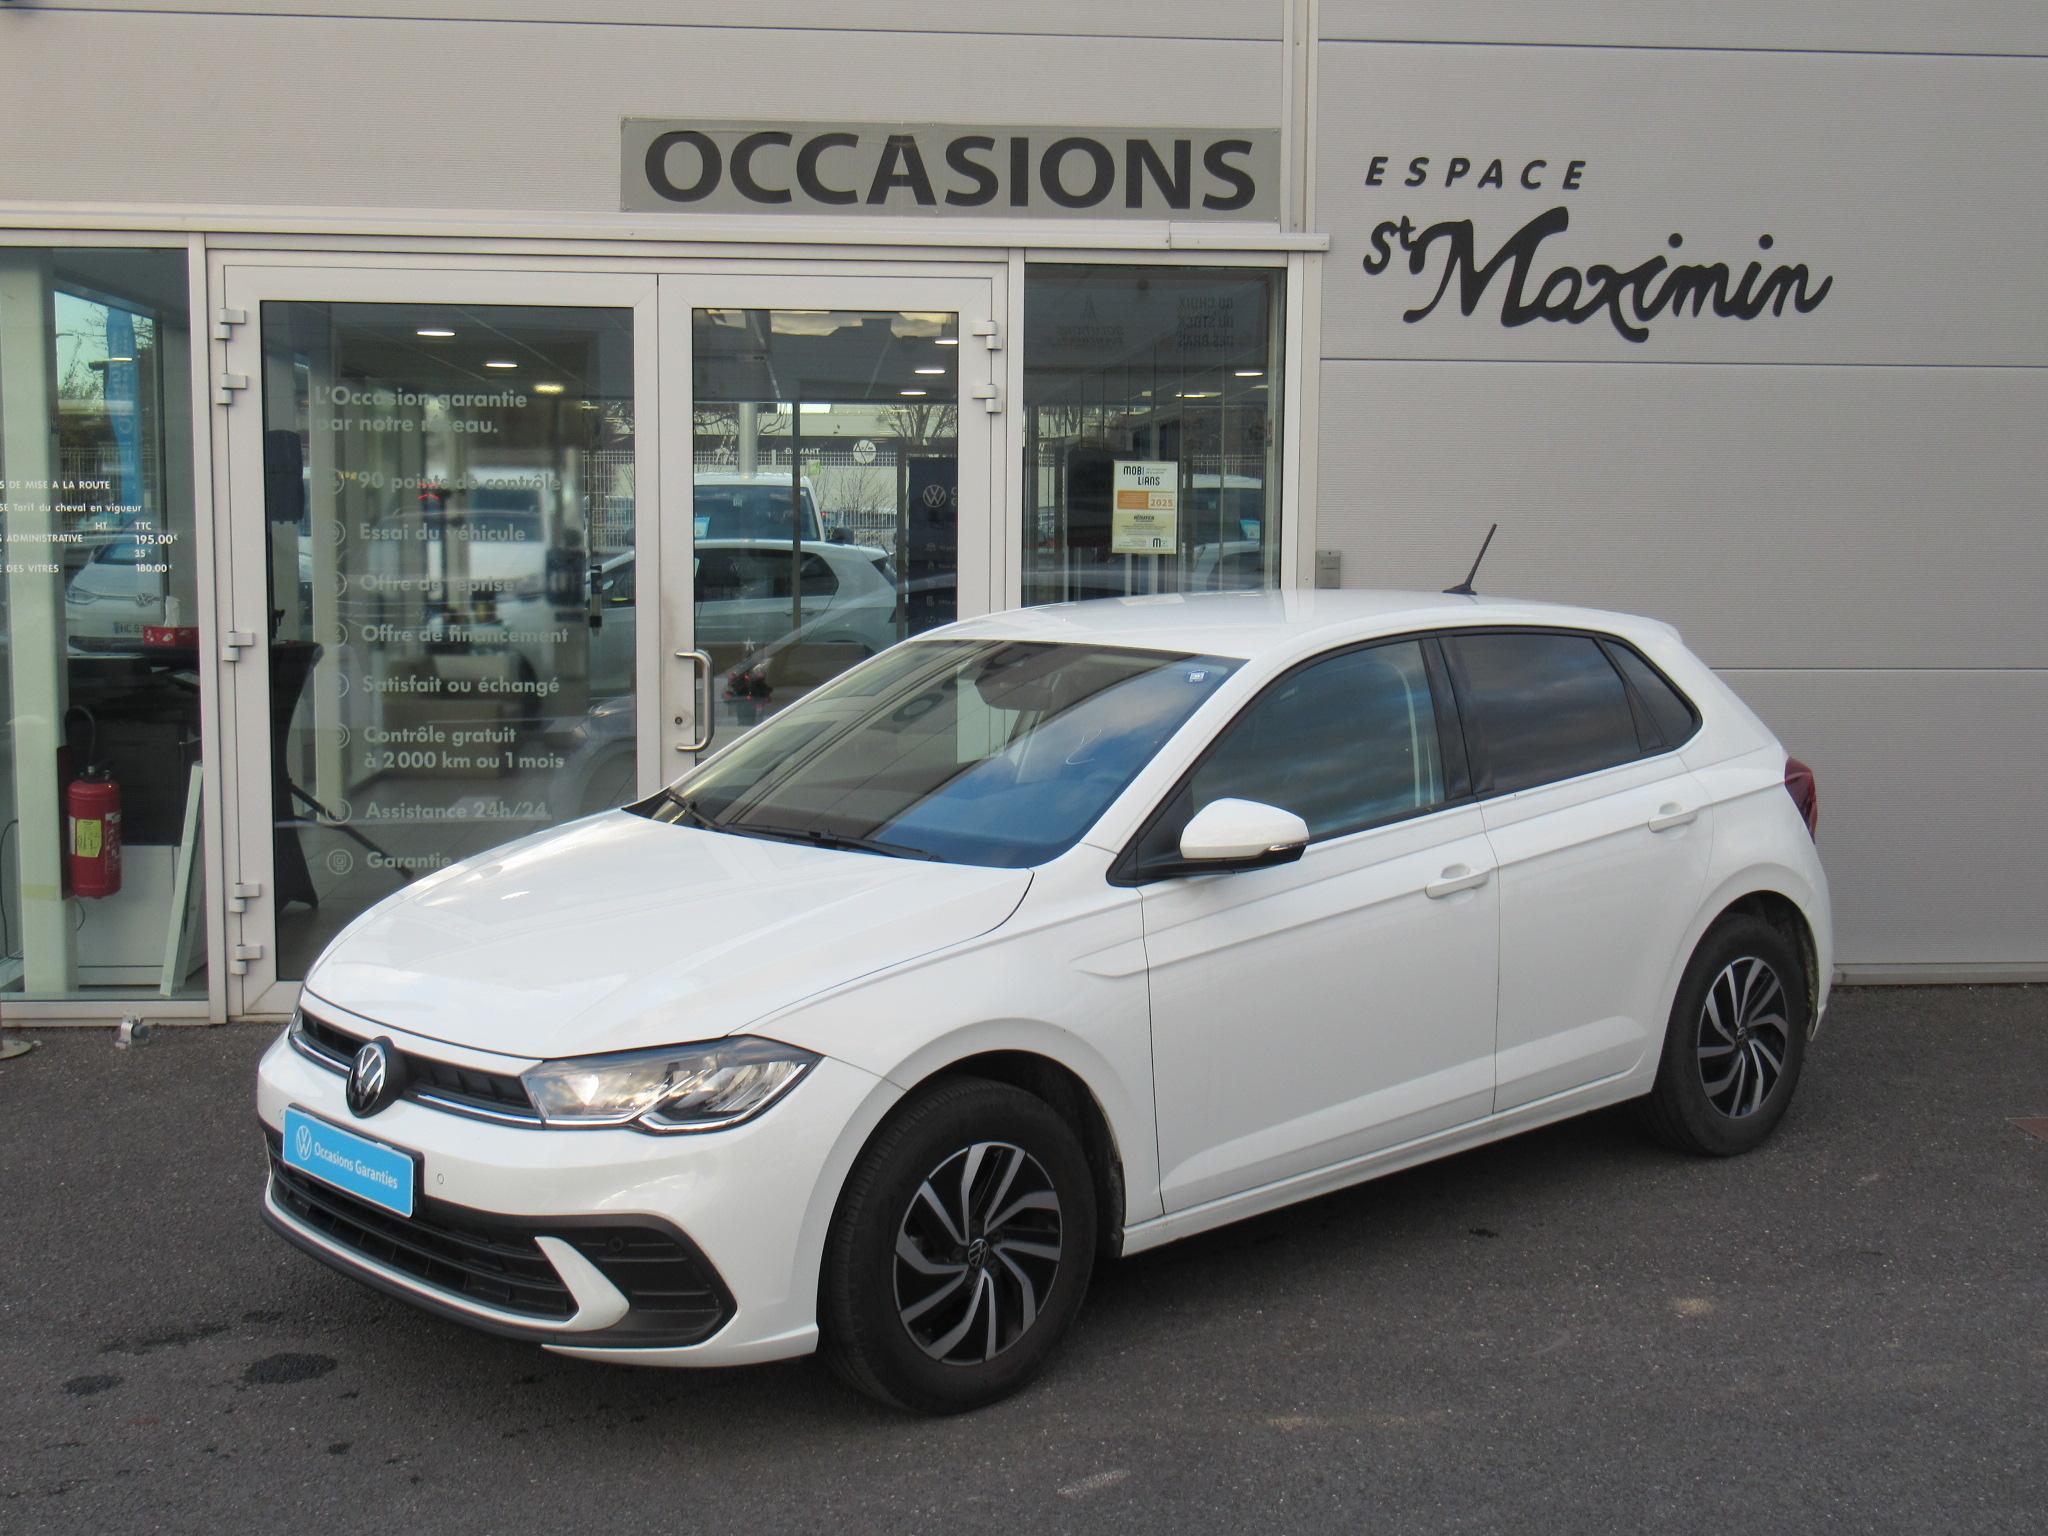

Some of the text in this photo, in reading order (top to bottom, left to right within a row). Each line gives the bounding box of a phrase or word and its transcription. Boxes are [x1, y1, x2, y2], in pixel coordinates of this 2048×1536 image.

[644, 130, 1256, 211] OCCASIONS
[1365, 156, 1586, 190] ESPACE
[1403, 206, 1833, 343] Maximin
[438, 390, 527, 410] garantie
[359, 416, 413, 432] notre
[421, 417, 498, 433] reau.
[9, 480, 21, 489] DE
[25, 480, 48, 489] MISE
[52, 480, 60, 489] A
[63, 480, 75, 489] LA
[79, 480, 110, 489] ROUTE
[358, 471, 561, 492] 90 points de contrôle
[13, 503, 34, 512] Tarif
[40, 503, 51, 512] du
[55, 503, 86, 512] cheval
[90, 504, 102, 512] en
[106, 504, 142, 515] vigueur
[1150, 498, 1174, 508] 2025
[95, 521, 152, 531] HT TTC
[359, 522, 526, 541] Essai du véhicule
[6, 535, 83, 543] ADMINISTRATIVE
[6, 565, 24, 573] DES
[28, 565, 59, 573] VITRES
[360, 574, 515, 595] Offre de eprise
[361, 623, 569, 643] Offre de financement
[362, 675, 560, 697] Satisfait ou échangé
[363, 724, 517, 747] Contrôle gratuit
[364, 753, 377, 769] à
[442, 751, 471, 769] km
[476, 755, 500, 769] ou
[505, 751, 513, 769] 1
[519, 752, 565, 769] mois
[365, 801, 547, 819] Assistance 24h/24
[366, 851, 452, 869] Garantie
[314, 1142, 354, 1172] Occasions
[354, 1159, 398, 1190] Garanties
